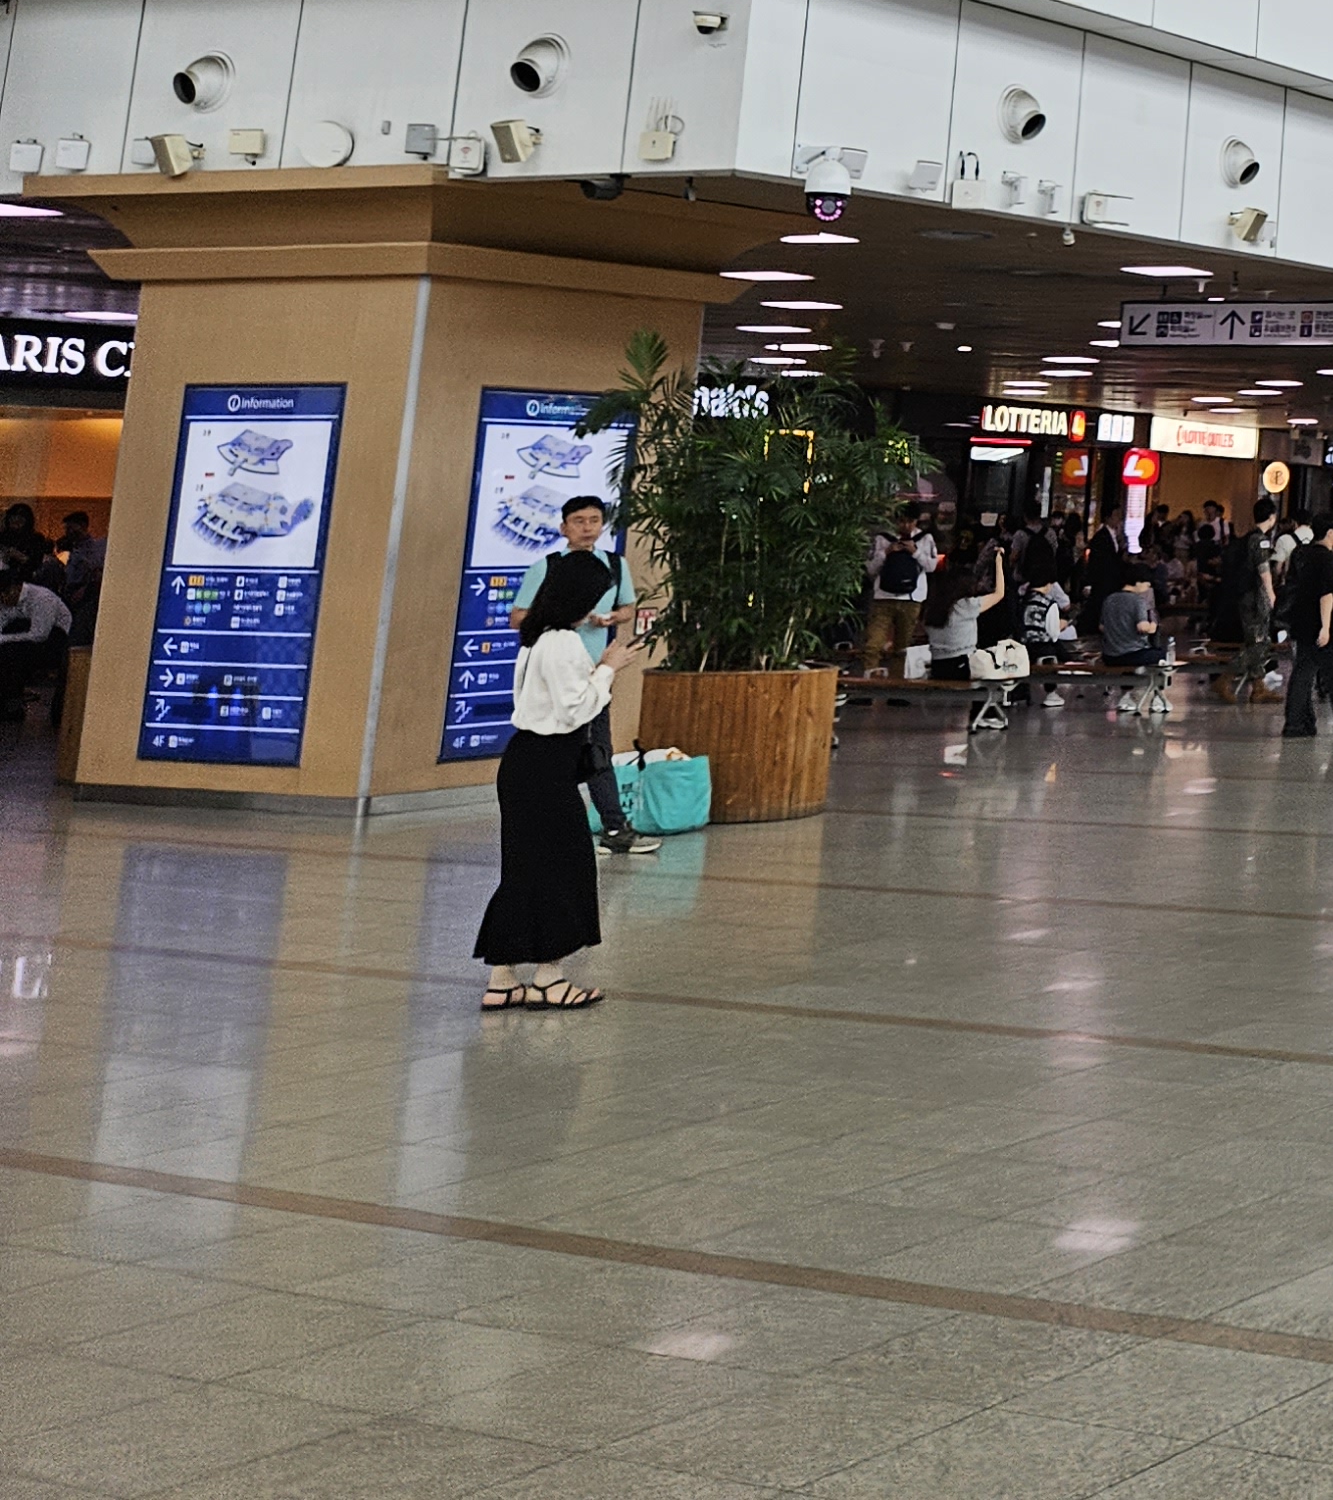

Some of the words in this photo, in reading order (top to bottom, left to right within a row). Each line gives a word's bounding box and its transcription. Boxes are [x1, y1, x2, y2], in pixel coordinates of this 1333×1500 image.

[241, 397, 294, 410] Information
[982, 404, 1068, 436] LOTTERIA
[152, 735, 165, 747] 4F
[453, 735, 466, 749] 4F
